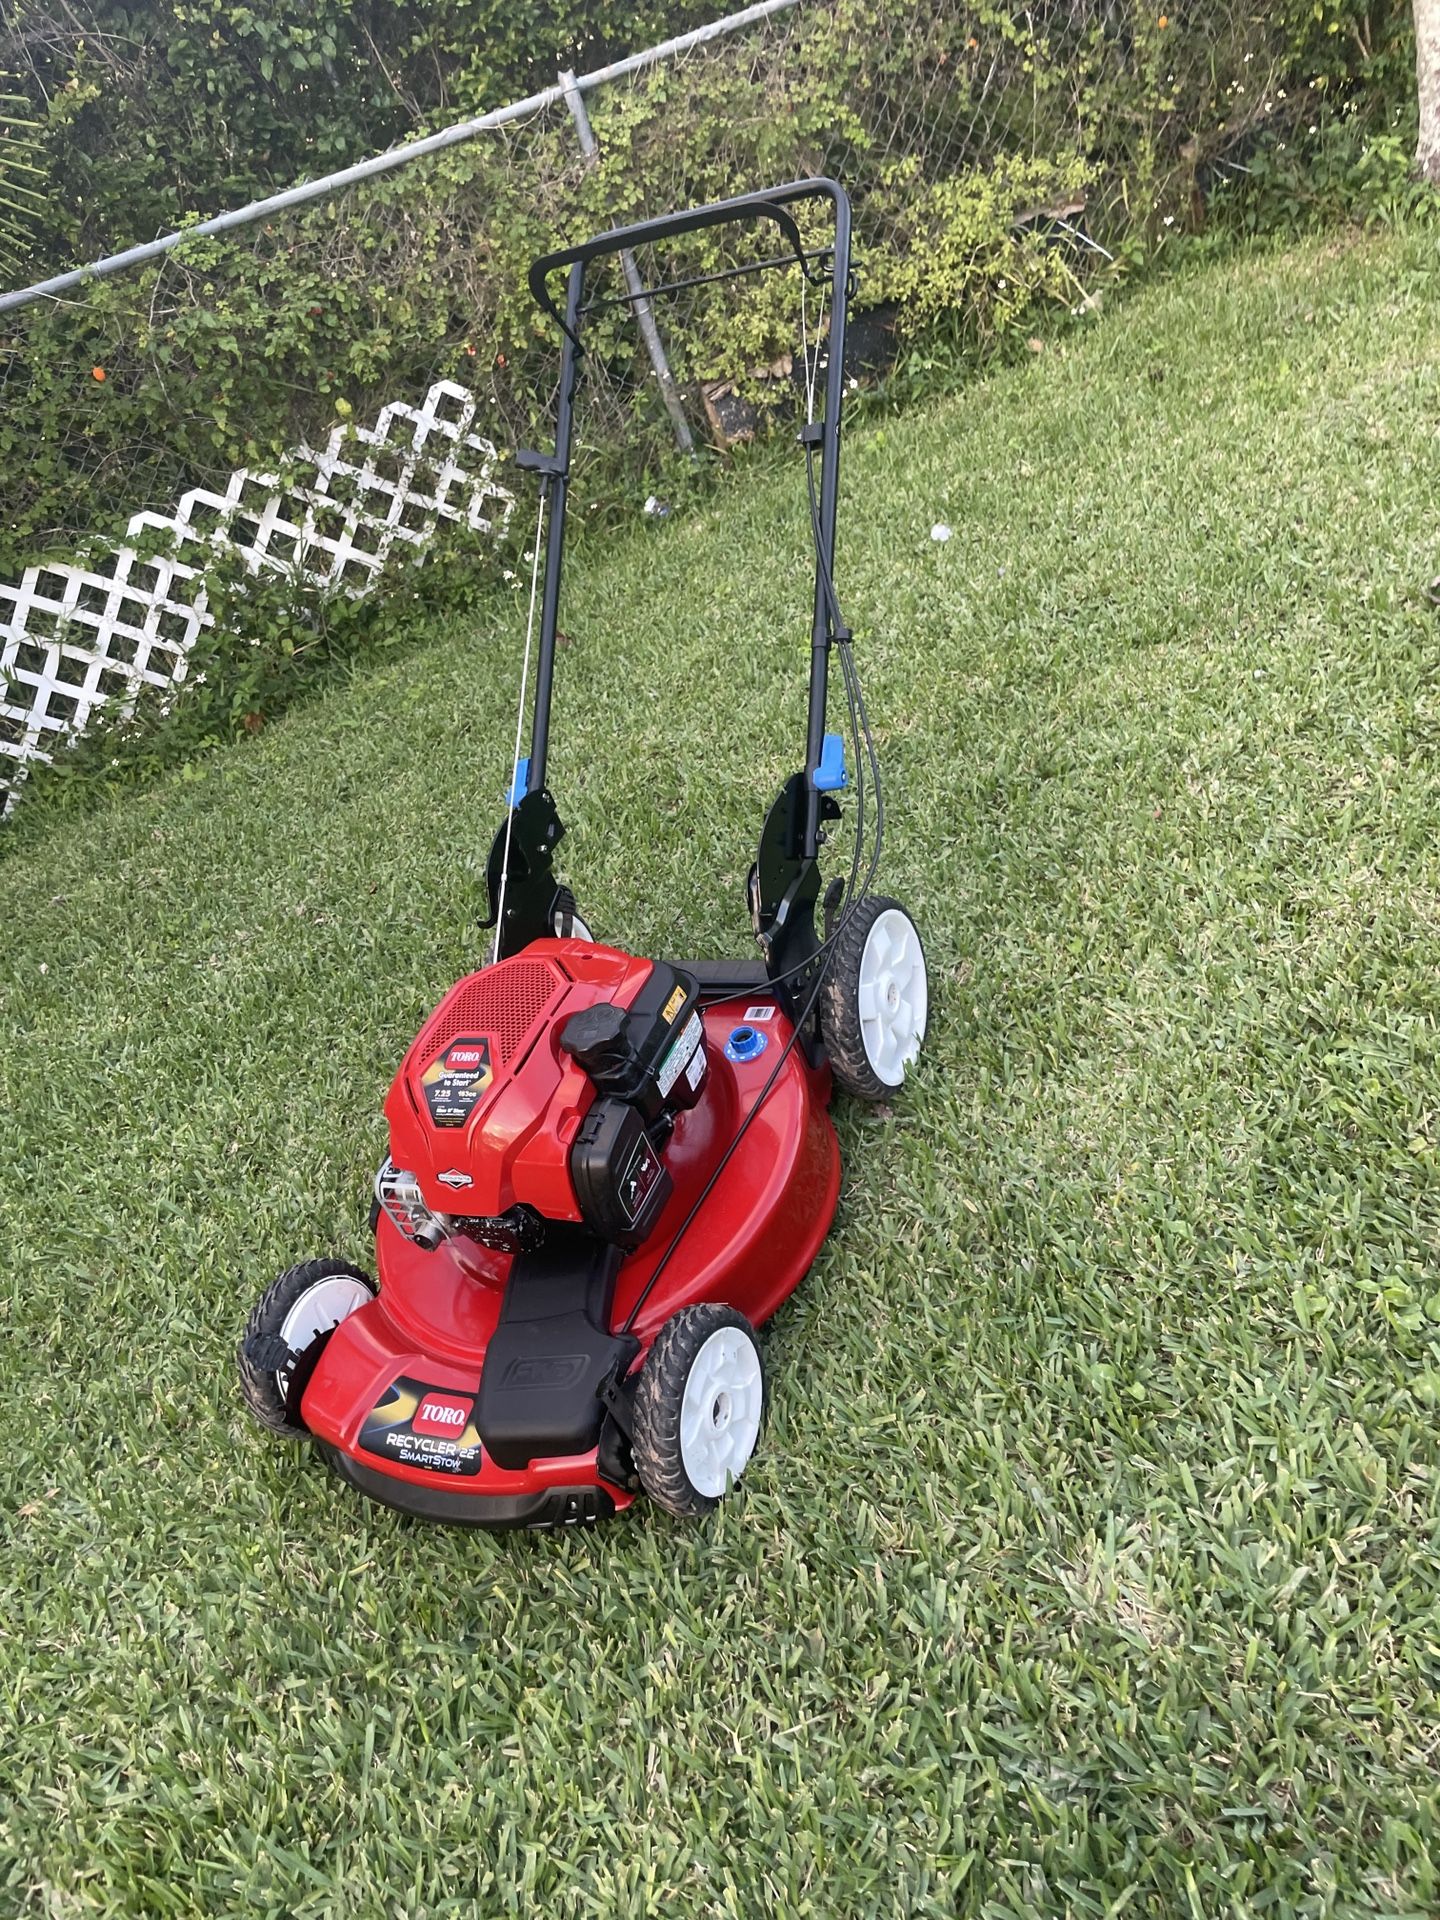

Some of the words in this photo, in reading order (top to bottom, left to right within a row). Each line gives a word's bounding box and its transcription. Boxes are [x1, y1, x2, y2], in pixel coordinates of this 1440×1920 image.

[451, 1051, 480, 1062] TORO
[439, 1071, 479, 1079] Guaranteed
[434, 1089, 451, 1098] 7.25
[421, 1403, 465, 1426] TORO
[386, 1432, 457, 1456] RECYCLER
